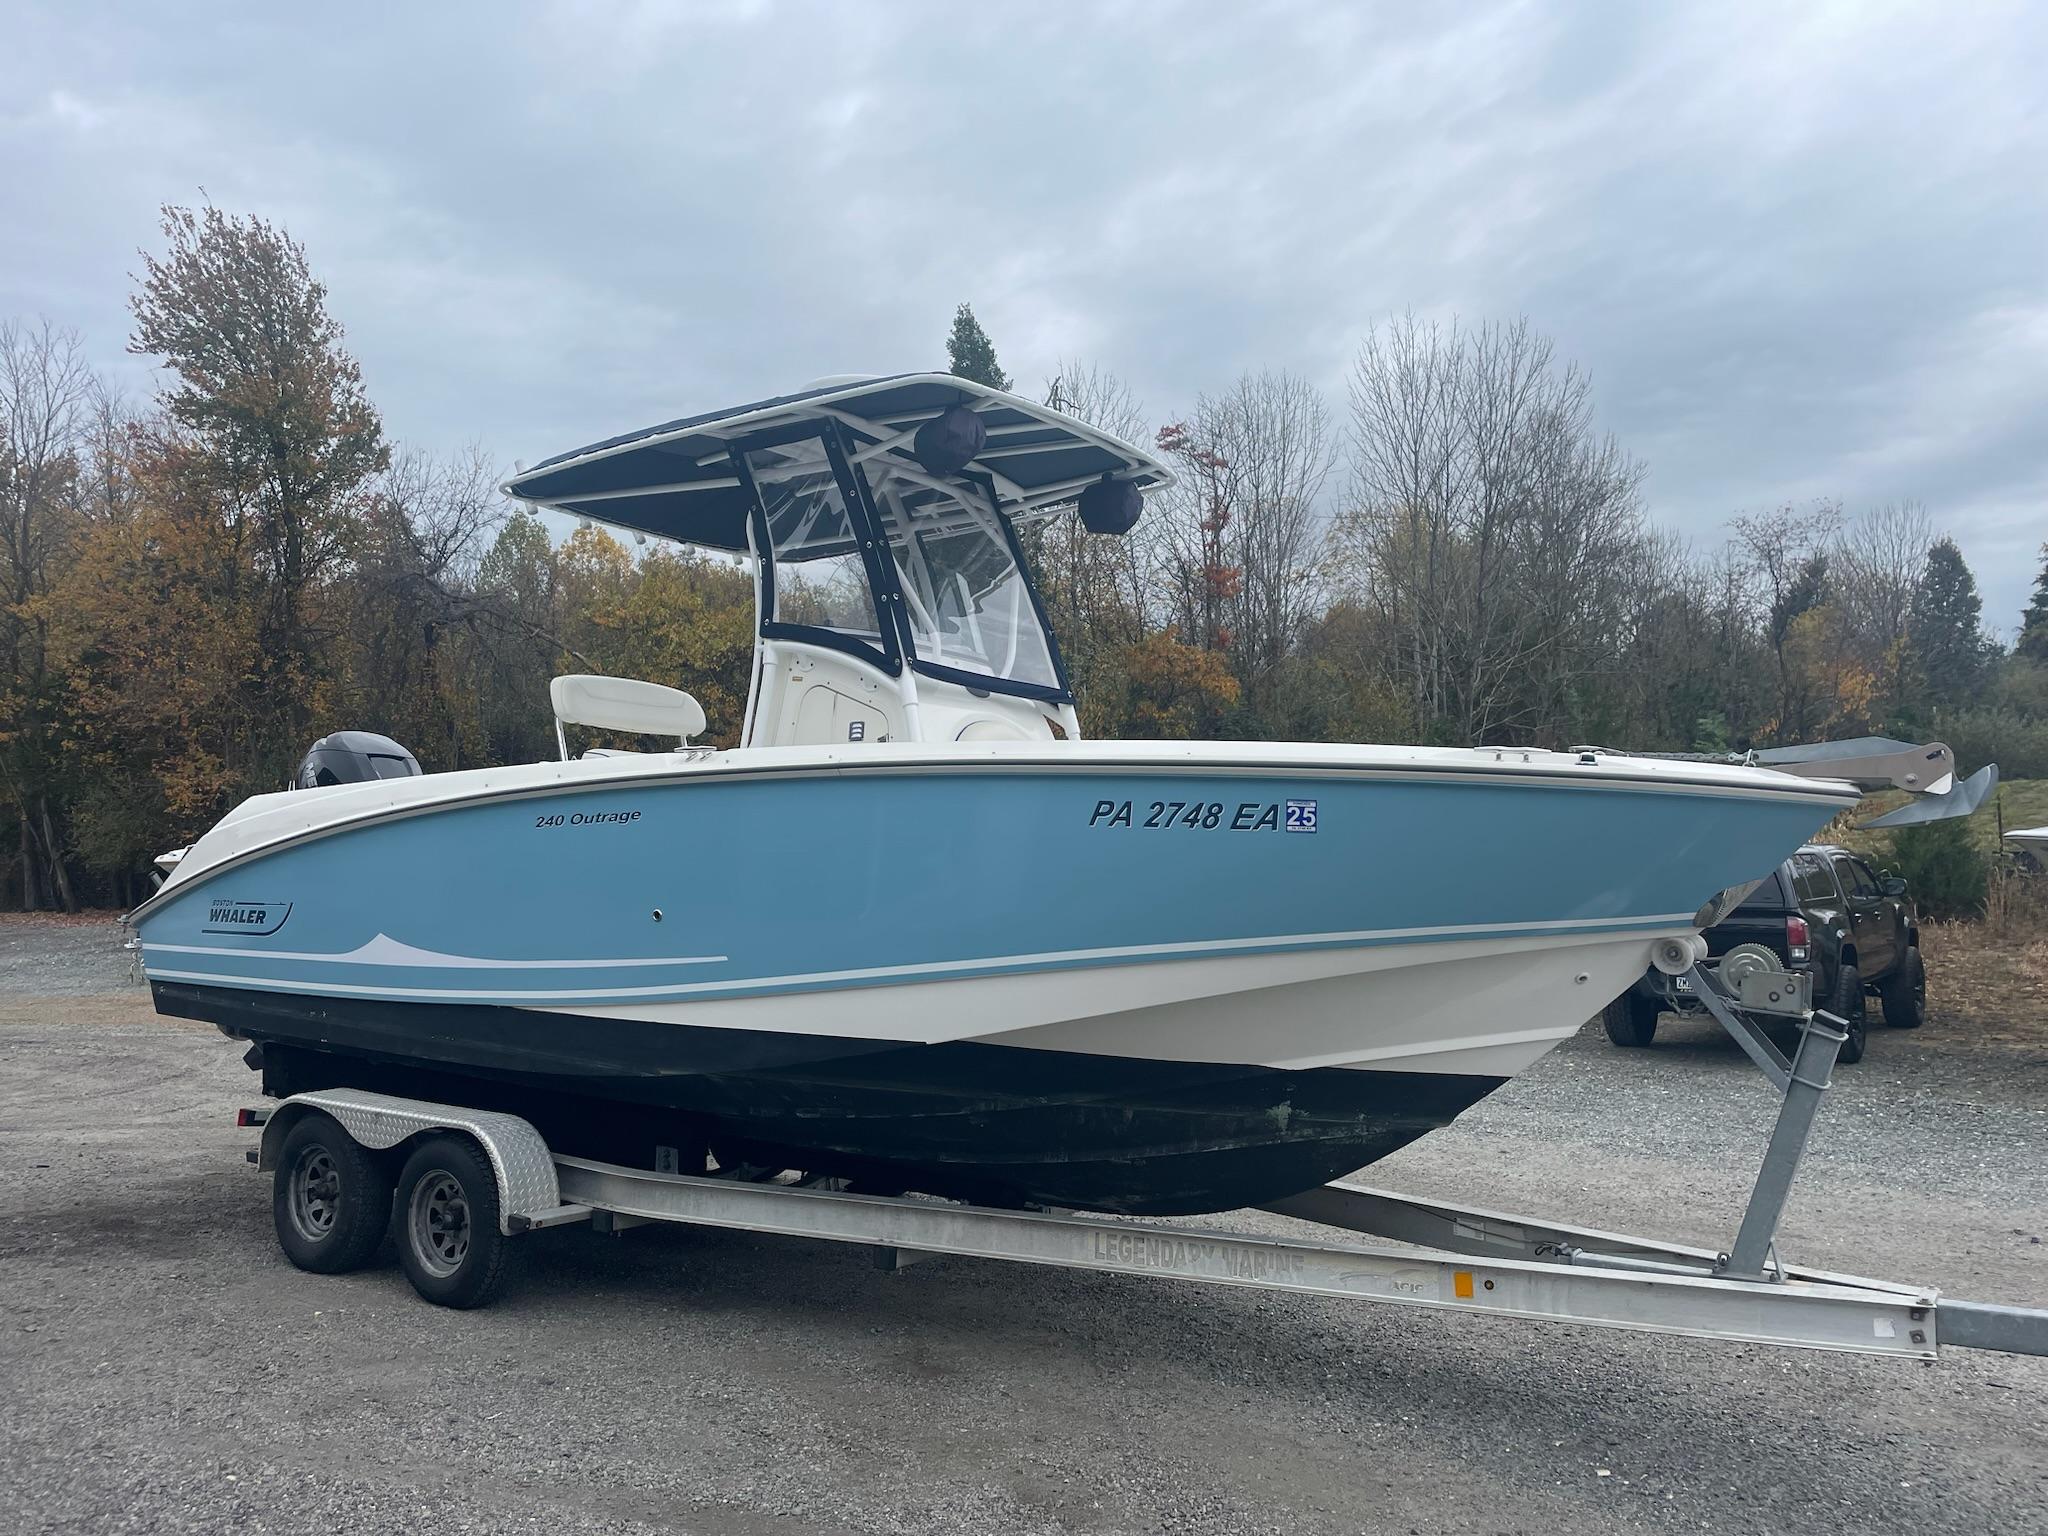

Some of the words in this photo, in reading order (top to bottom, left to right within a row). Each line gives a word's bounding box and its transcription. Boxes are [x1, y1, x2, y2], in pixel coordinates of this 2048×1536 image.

[536, 815, 565, 828] 240
[570, 811, 642, 825] Outrage
[1089, 800, 1132, 827] PA
[1143, 801, 1224, 829] 2748
[1230, 803, 1280, 831] EA
[1287, 806, 1316, 827] 25
[209, 908, 267, 924] WHALER
